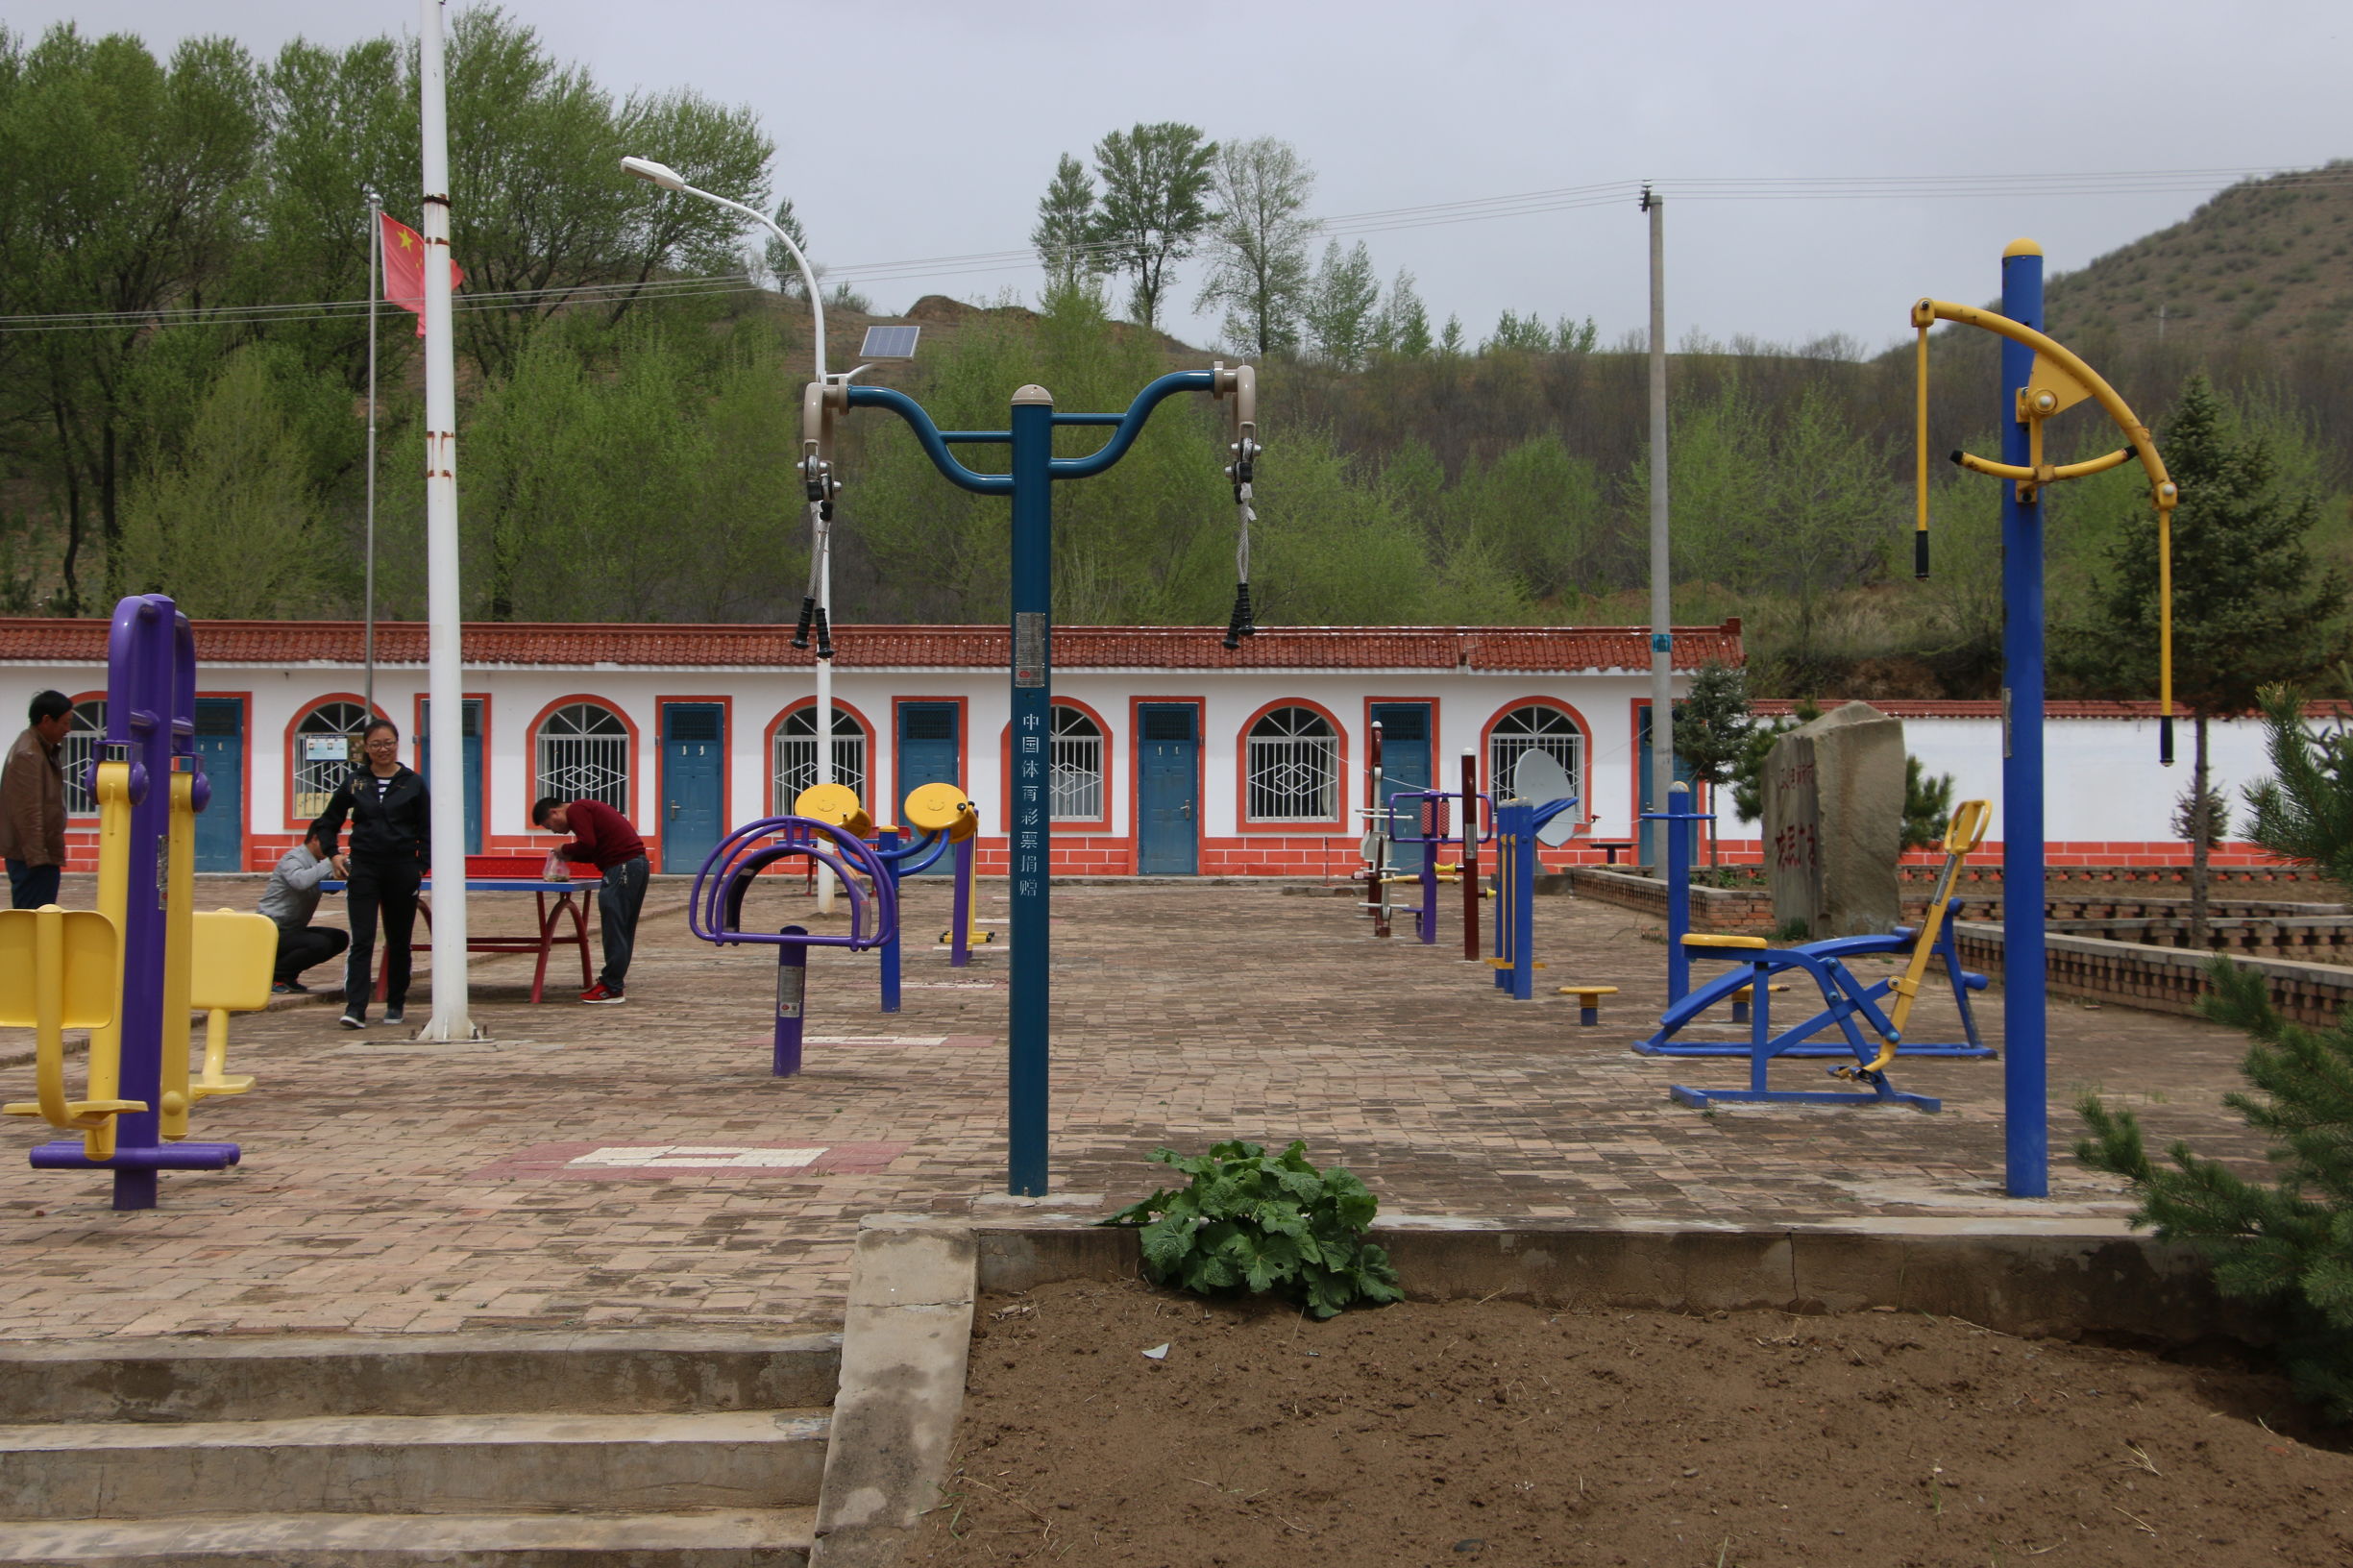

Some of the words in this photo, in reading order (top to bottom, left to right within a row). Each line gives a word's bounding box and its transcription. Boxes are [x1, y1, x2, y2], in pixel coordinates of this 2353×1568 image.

[1020, 713, 1039, 896] 中国体育彩票捐赠
